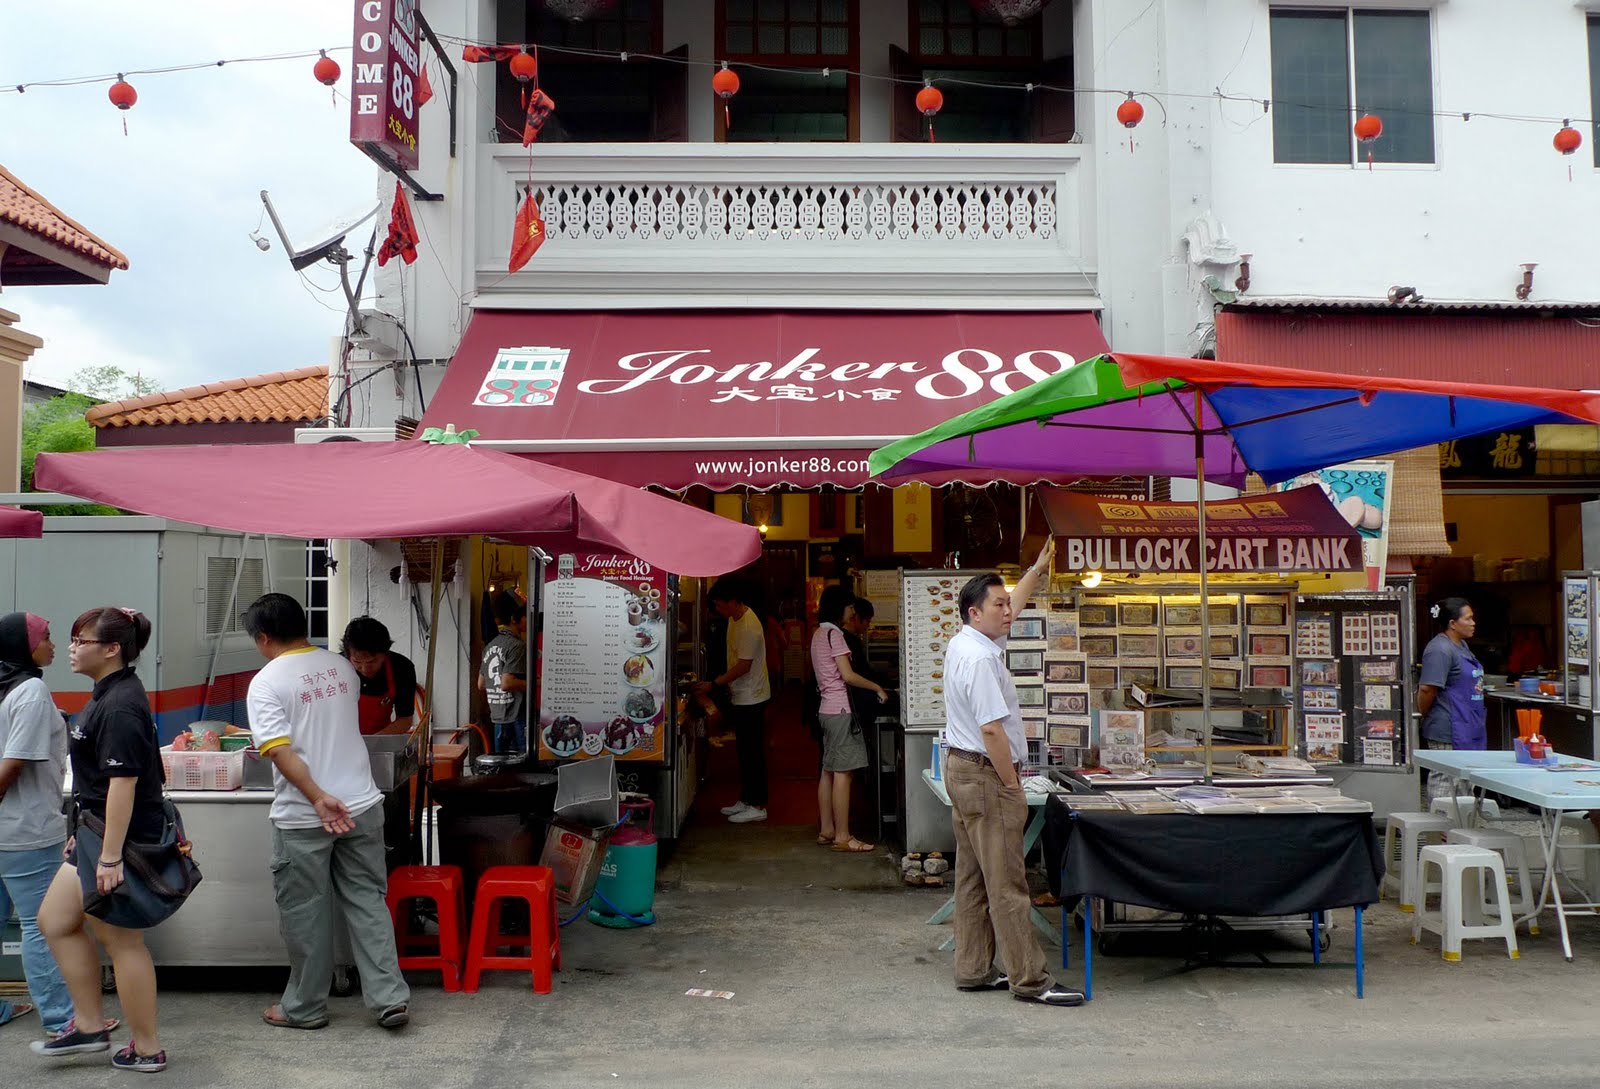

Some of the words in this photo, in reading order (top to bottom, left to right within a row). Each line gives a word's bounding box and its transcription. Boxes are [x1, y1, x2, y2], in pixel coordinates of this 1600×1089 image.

[389, 23, 418, 76] JONKER
[392, 61, 413, 119] 88
[577, 348, 927, 394] Jonker
[915, 348, 1075, 400] 88
[709, 383, 902, 402] 大宝小食
[581, 554, 631, 572] Jonker
[1068, 538, 1192, 570] BULLOCK
[1204, 538, 1269, 570] CART
[1277, 538, 1351, 569] BANK
[300, 668, 338, 686] 马六甲
[600, 863, 617, 873] AS
